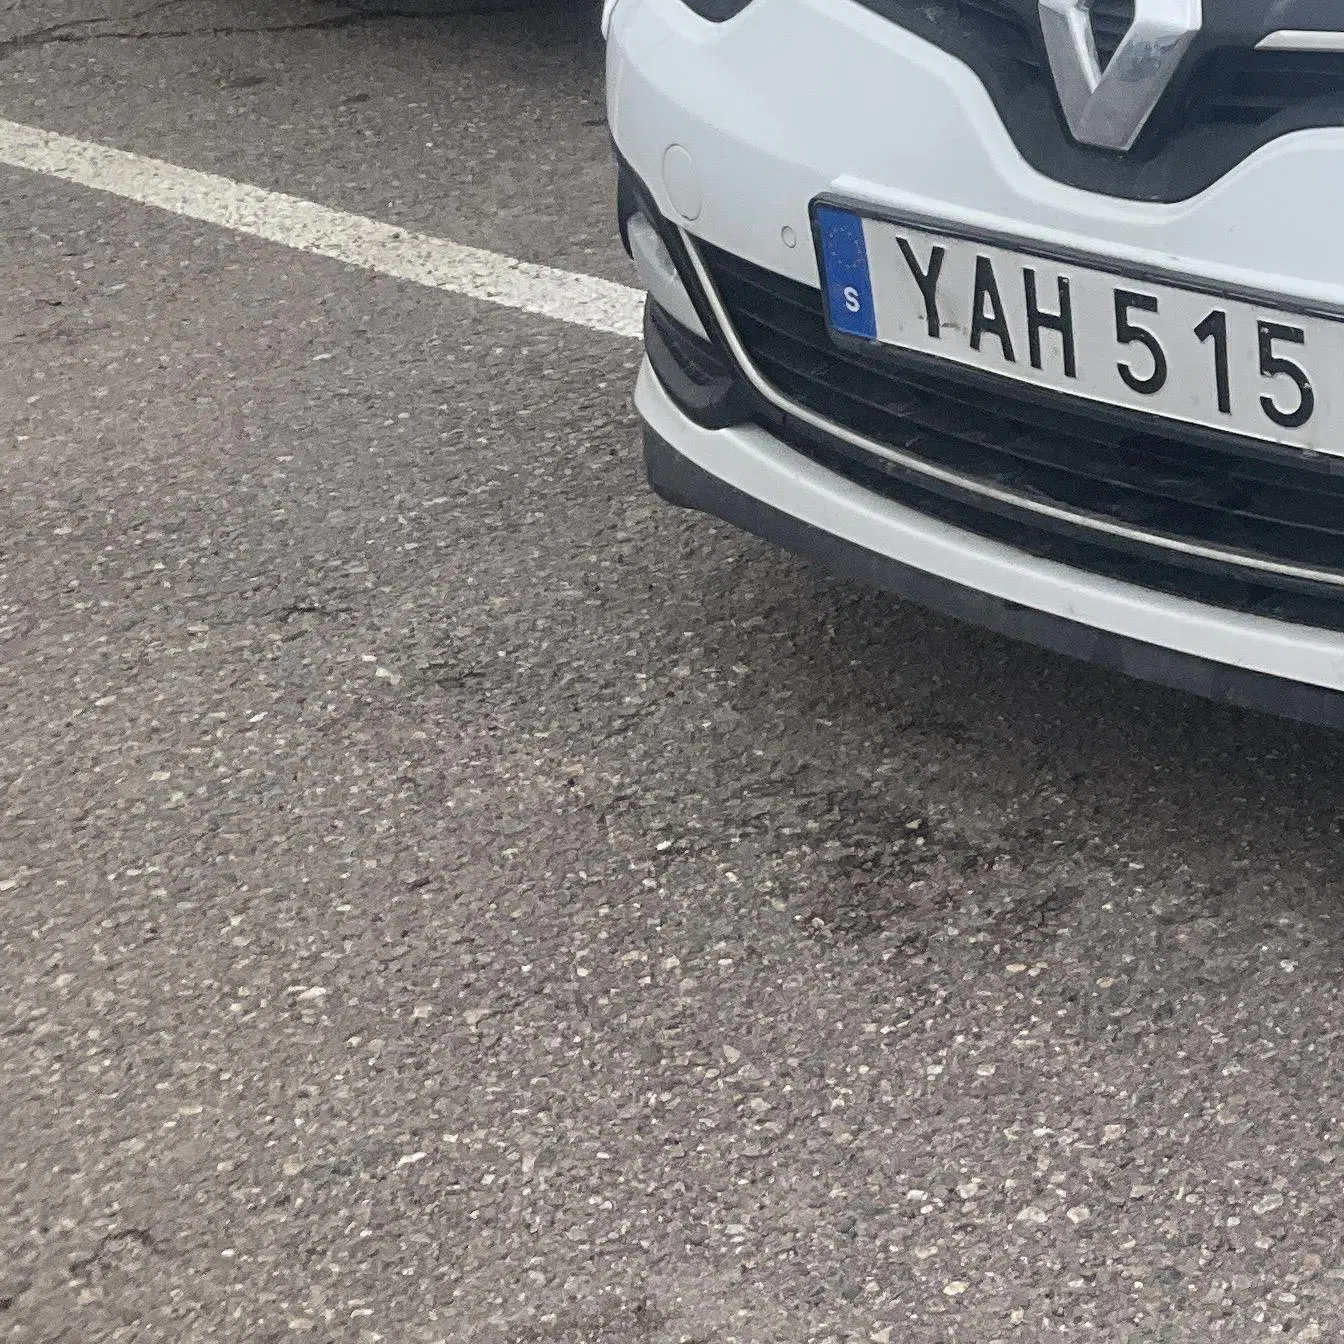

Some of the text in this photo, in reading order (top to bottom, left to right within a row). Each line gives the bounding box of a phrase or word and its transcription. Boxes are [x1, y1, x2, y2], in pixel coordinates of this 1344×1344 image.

[843, 286, 862, 314] S
[895, 236, 1314, 429] YAH 515
